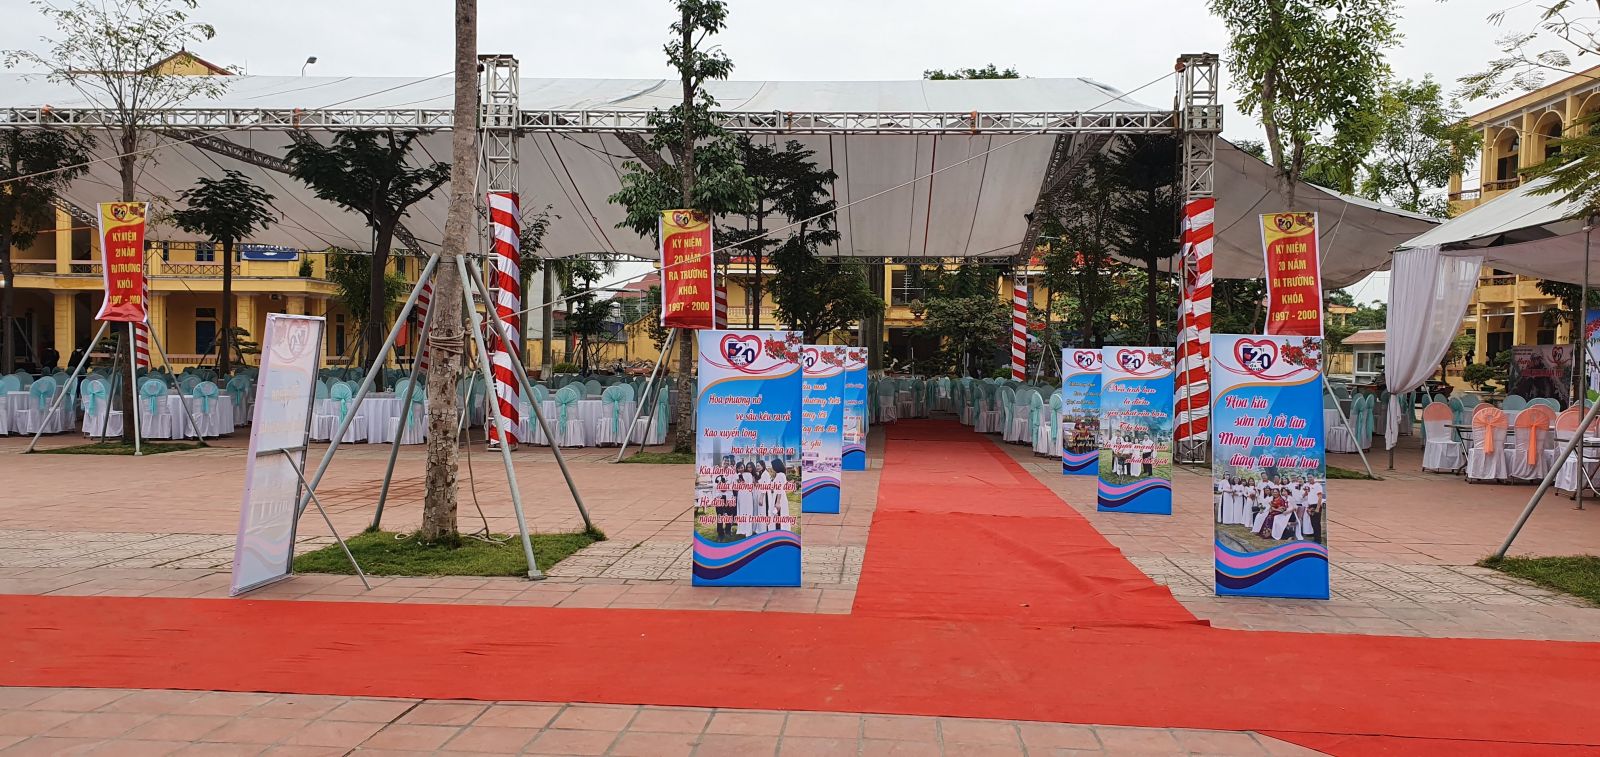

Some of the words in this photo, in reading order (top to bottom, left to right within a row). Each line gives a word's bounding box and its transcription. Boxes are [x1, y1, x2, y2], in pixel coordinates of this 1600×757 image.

[684, 238, 702, 250] NIỆM
[1286, 242, 1306, 255] NIỆM
[674, 255, 683, 264] 20
[1287, 260, 1306, 270] NĂM
[669, 271, 678, 280] RA
[681, 268, 708, 280] TRƯỜNG
[1283, 275, 1314, 288] TRƯỜNG
[678, 283, 698, 296] KHÓA
[1282, 292, 1303, 304] KHÓA
[668, 302, 684, 312] 1997
[692, 301, 710, 311] 2000
[1272, 311, 1289, 321] 1997
[1298, 310, 1317, 320] 2000
[709, 394, 723, 404] Hoa
[1225, 396, 1247, 408] Hoa
[1251, 396, 1267, 408] kia
[1258, 414, 1272, 427] nở
[704, 428, 717, 437] Xao
[1219, 432, 1250, 448] Mong
[1253, 434, 1270, 447] cho
[1296, 435, 1316, 450] bạn
[1230, 454, 1254, 469] đừng
[1276, 456, 1297, 467] như
[1299, 456, 1319, 468] hoa
